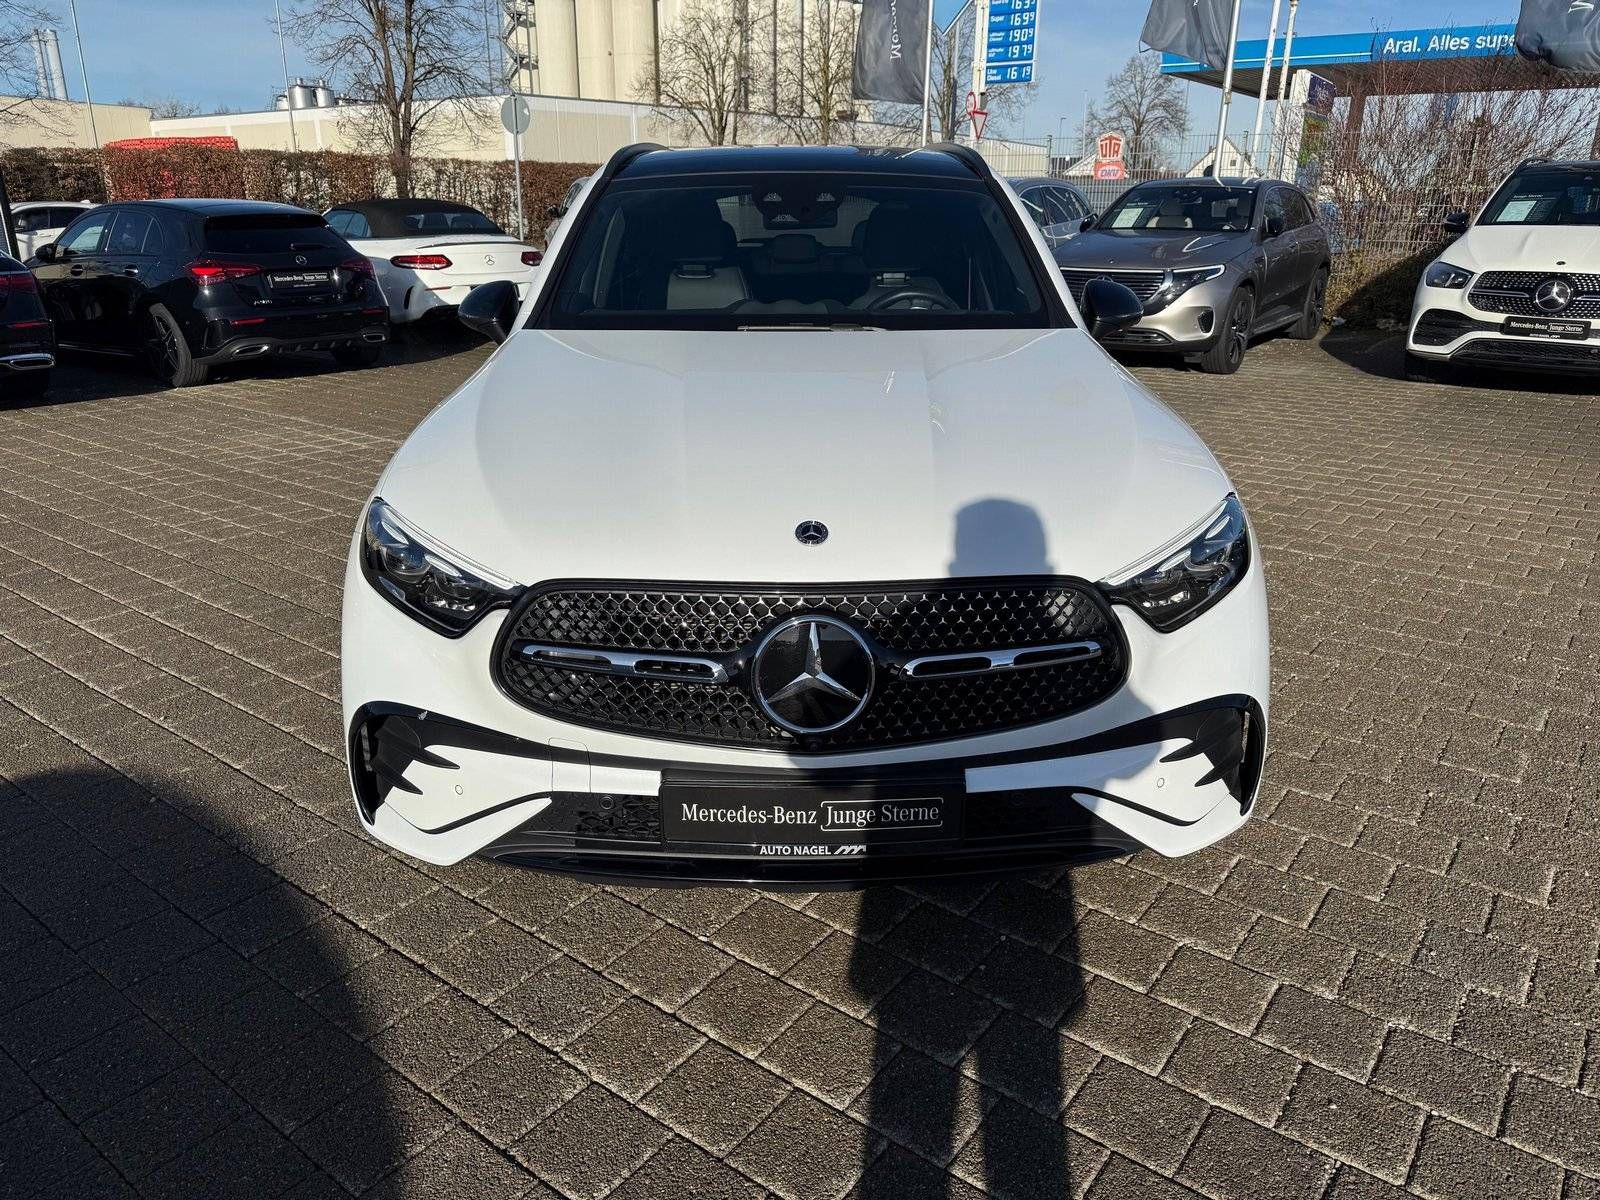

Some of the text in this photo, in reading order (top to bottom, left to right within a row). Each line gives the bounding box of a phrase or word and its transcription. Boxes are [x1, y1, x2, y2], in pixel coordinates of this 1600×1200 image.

[1383, 36, 1421, 54] Aral.
[1427, 34, 1470, 51] Alles
[1100, 135, 1122, 158] UTA
[1510, 321, 1547, 330] Mercedes-Benz
[681, 803, 939, 827] Mercedes-Benz Junge Sterne
[760, 845, 831, 855] AUTO NAGEL
